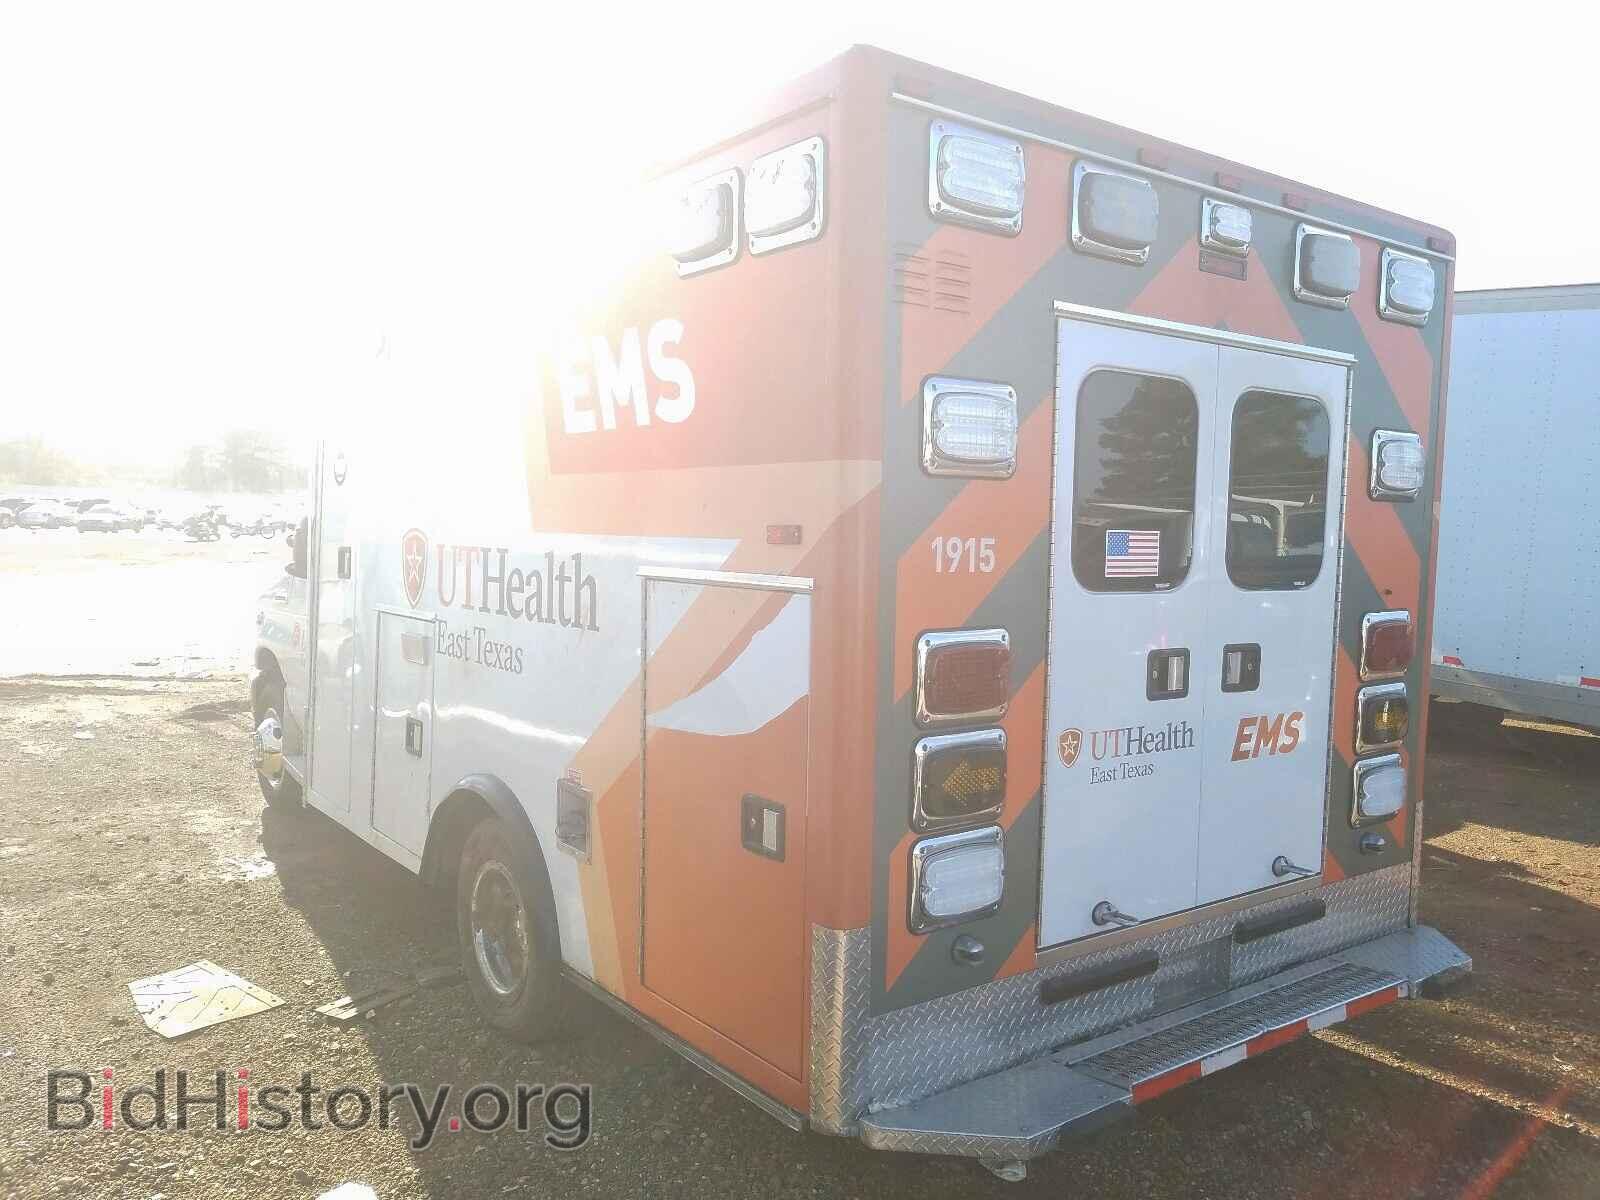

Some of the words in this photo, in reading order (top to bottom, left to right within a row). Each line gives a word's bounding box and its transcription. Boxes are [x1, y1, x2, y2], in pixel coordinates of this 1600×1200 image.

[557, 317, 696, 434] EMS
[930, 536, 996, 573] 1915
[436, 543, 600, 632] UTHealth
[435, 619, 472, 658] East
[473, 625, 524, 675] Texas
[1089, 721, 1195, 761] UTHealth
[1231, 711, 1304, 762] EMS
[1089, 765, 1117, 785] East
[1119, 762, 1154, 778] Texas
